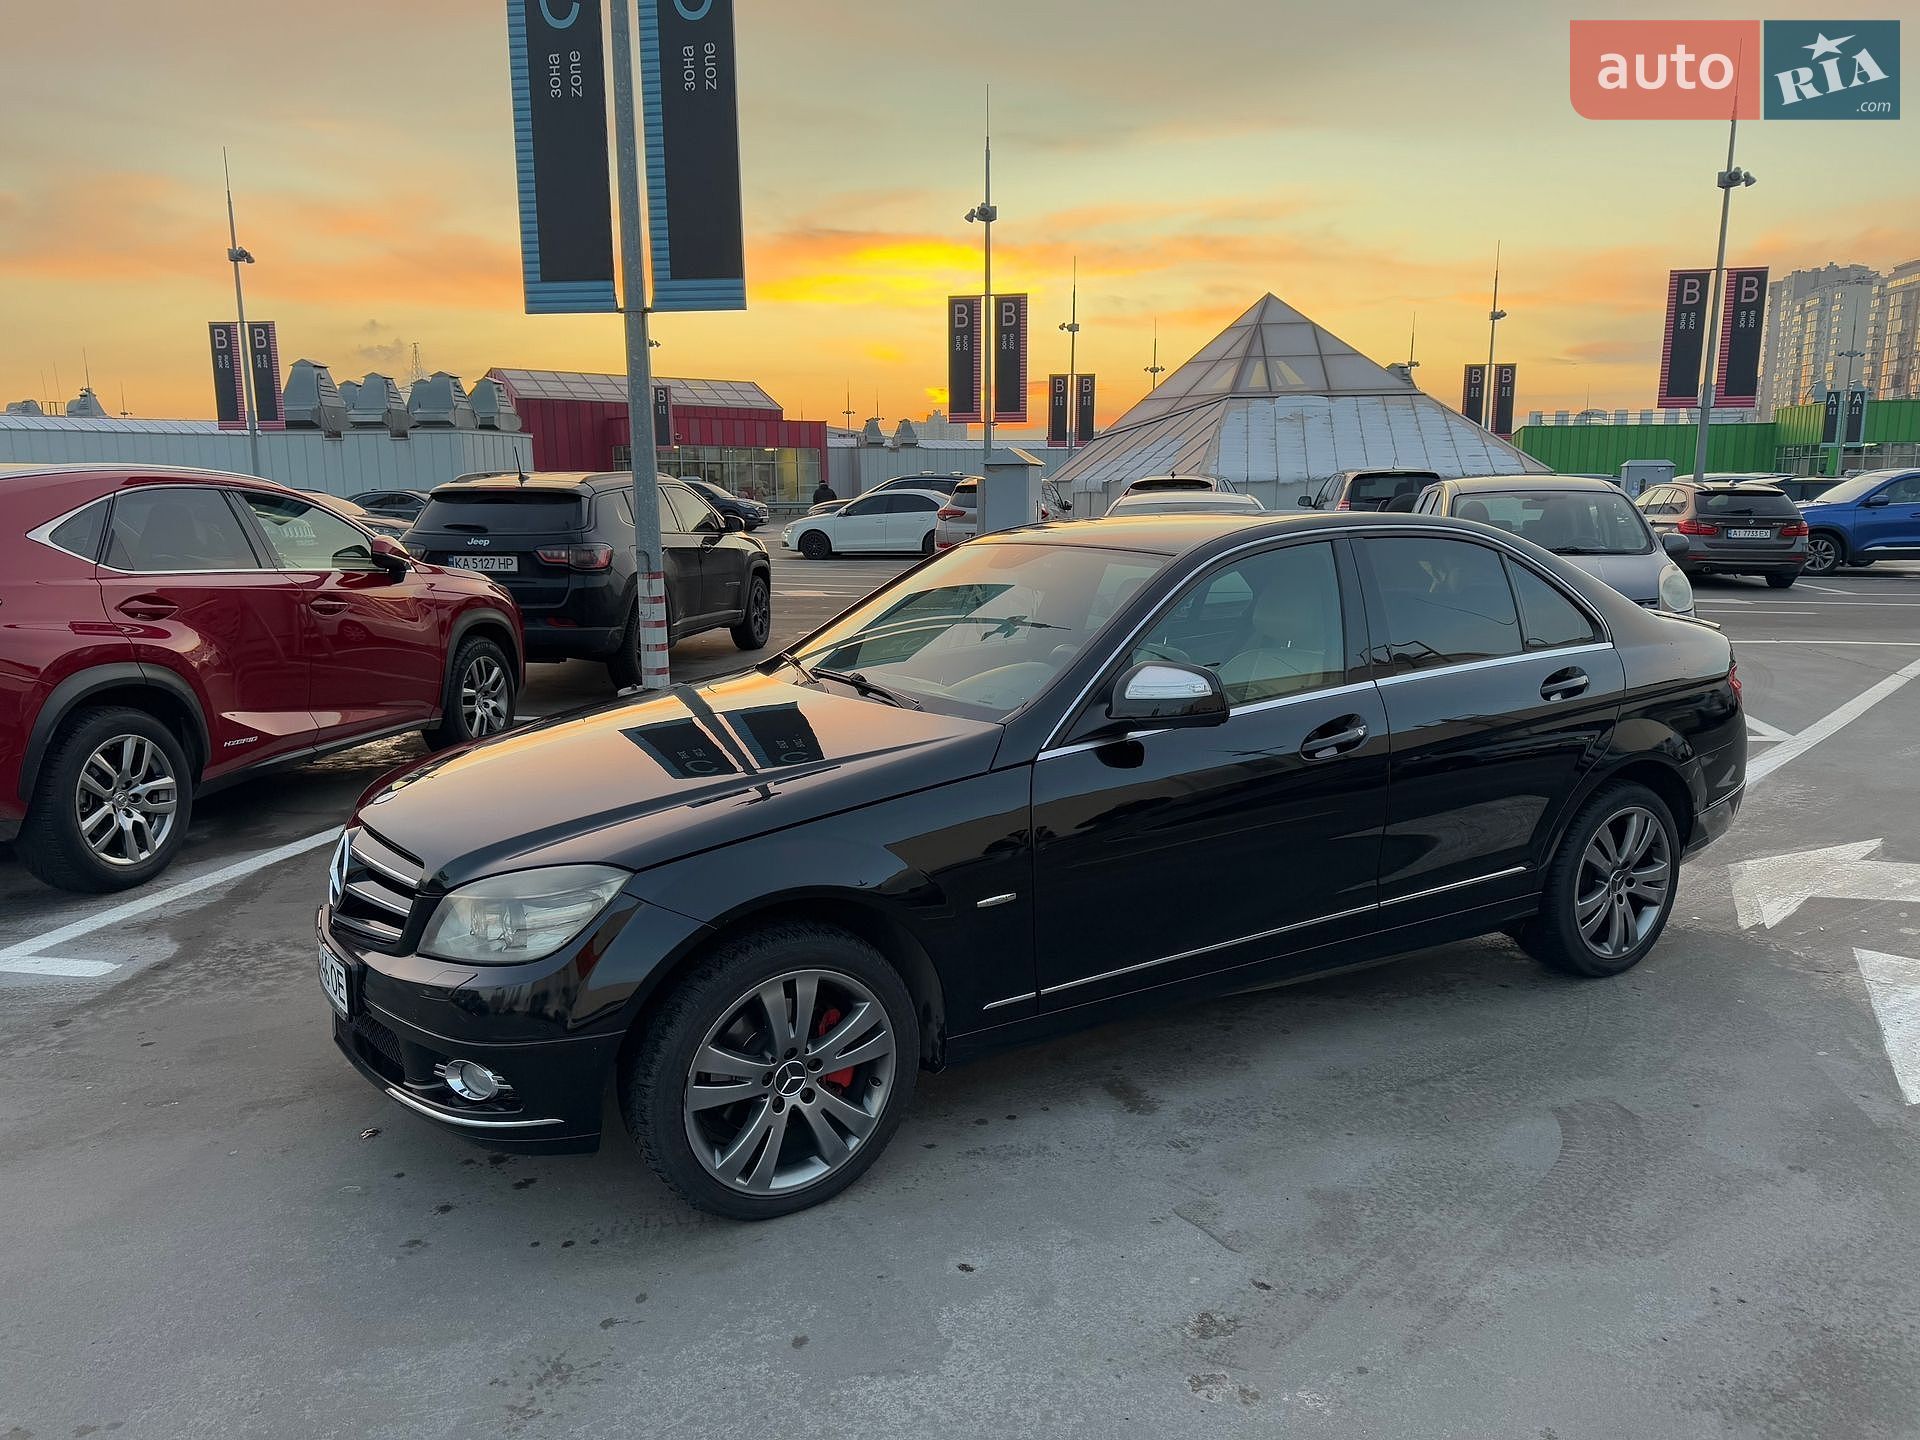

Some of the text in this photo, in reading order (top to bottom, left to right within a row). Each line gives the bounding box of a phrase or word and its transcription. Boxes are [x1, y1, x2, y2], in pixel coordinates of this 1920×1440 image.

[548, 52, 562, 98] зона
[569, 50, 583, 98] zone
[683, 45, 696, 92] зона
[704, 42, 718, 90] zone
[1682, 278, 1701, 305] B
[1740, 276, 1759, 303] B
[954, 304, 969, 329] B
[1002, 302, 1017, 327] B
[214, 328, 228, 350] B
[254, 327, 267, 349] B
[1055, 378, 1064, 393] B
[1082, 378, 1092, 393] B
[1471, 368, 1481, 383] B
[1501, 368, 1512, 383] B
[657, 389, 666, 403] B
[1827, 393, 1837, 405] A
[1852, 392, 1863, 405] A
[467, 537, 490, 547] Jeep
[454, 557, 514, 570] KA 5127 HP
